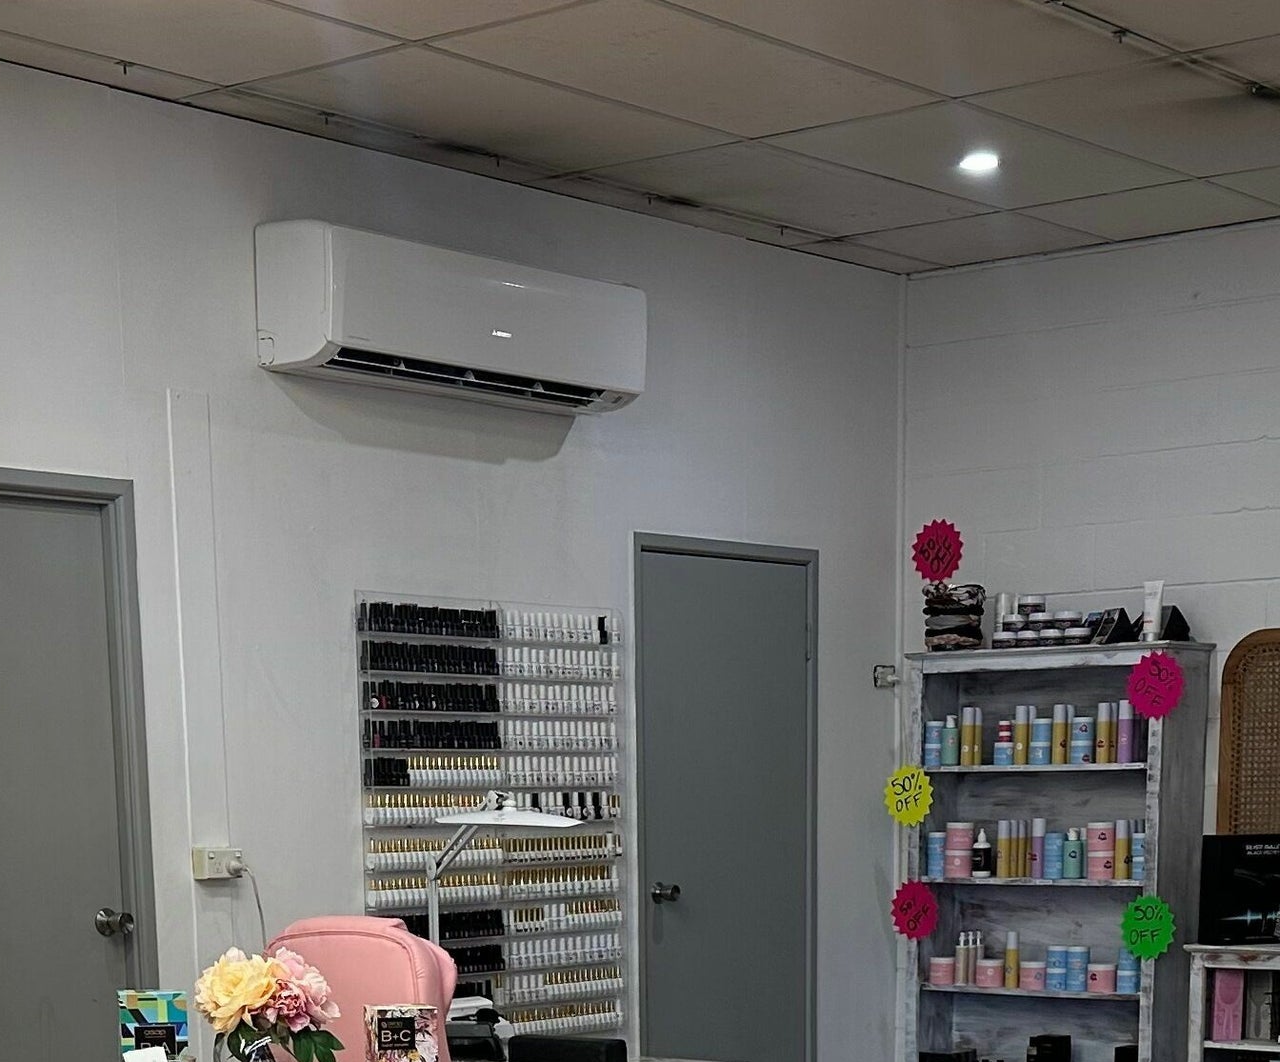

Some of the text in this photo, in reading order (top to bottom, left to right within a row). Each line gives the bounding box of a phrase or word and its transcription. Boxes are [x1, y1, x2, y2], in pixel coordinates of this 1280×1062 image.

[891, 772, 922, 796] 50%
[896, 792, 922, 813] OFF
[1134, 905, 1163, 921] 50%
[1130, 928, 1160, 946] OFF
[381, 1029, 411, 1042] B+C
